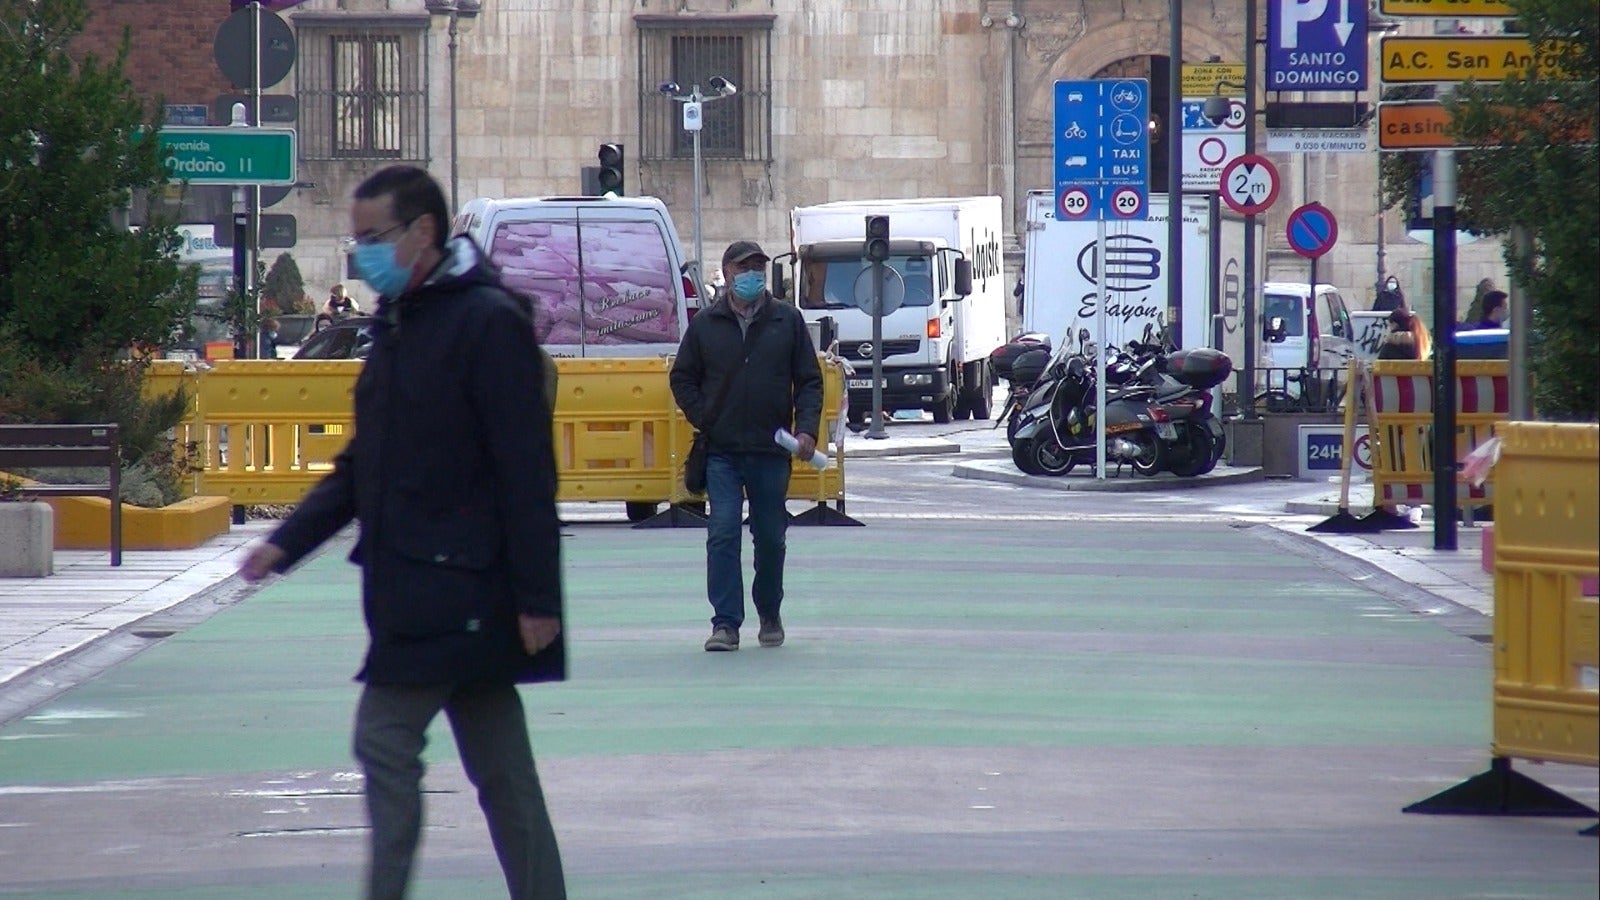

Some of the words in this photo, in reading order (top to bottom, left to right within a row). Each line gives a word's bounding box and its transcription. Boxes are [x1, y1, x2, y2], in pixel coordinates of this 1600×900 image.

[1289, 52, 1345, 66] SANTO
[1389, 51, 1433, 70] A.C.
[1447, 51, 1489, 70] San
[1503, 51, 1557, 69] Anto
[1275, 70, 1360, 84] DOMINGO
[1112, 149, 1140, 159] TAXI
[165, 156, 226, 172] Ordoño
[239, 158, 252, 172] II
[1113, 165, 1139, 175] BUS
[1067, 197, 1085, 208] 30
[1118, 197, 1136, 207] 20
[1309, 444, 1343, 459] 24H
